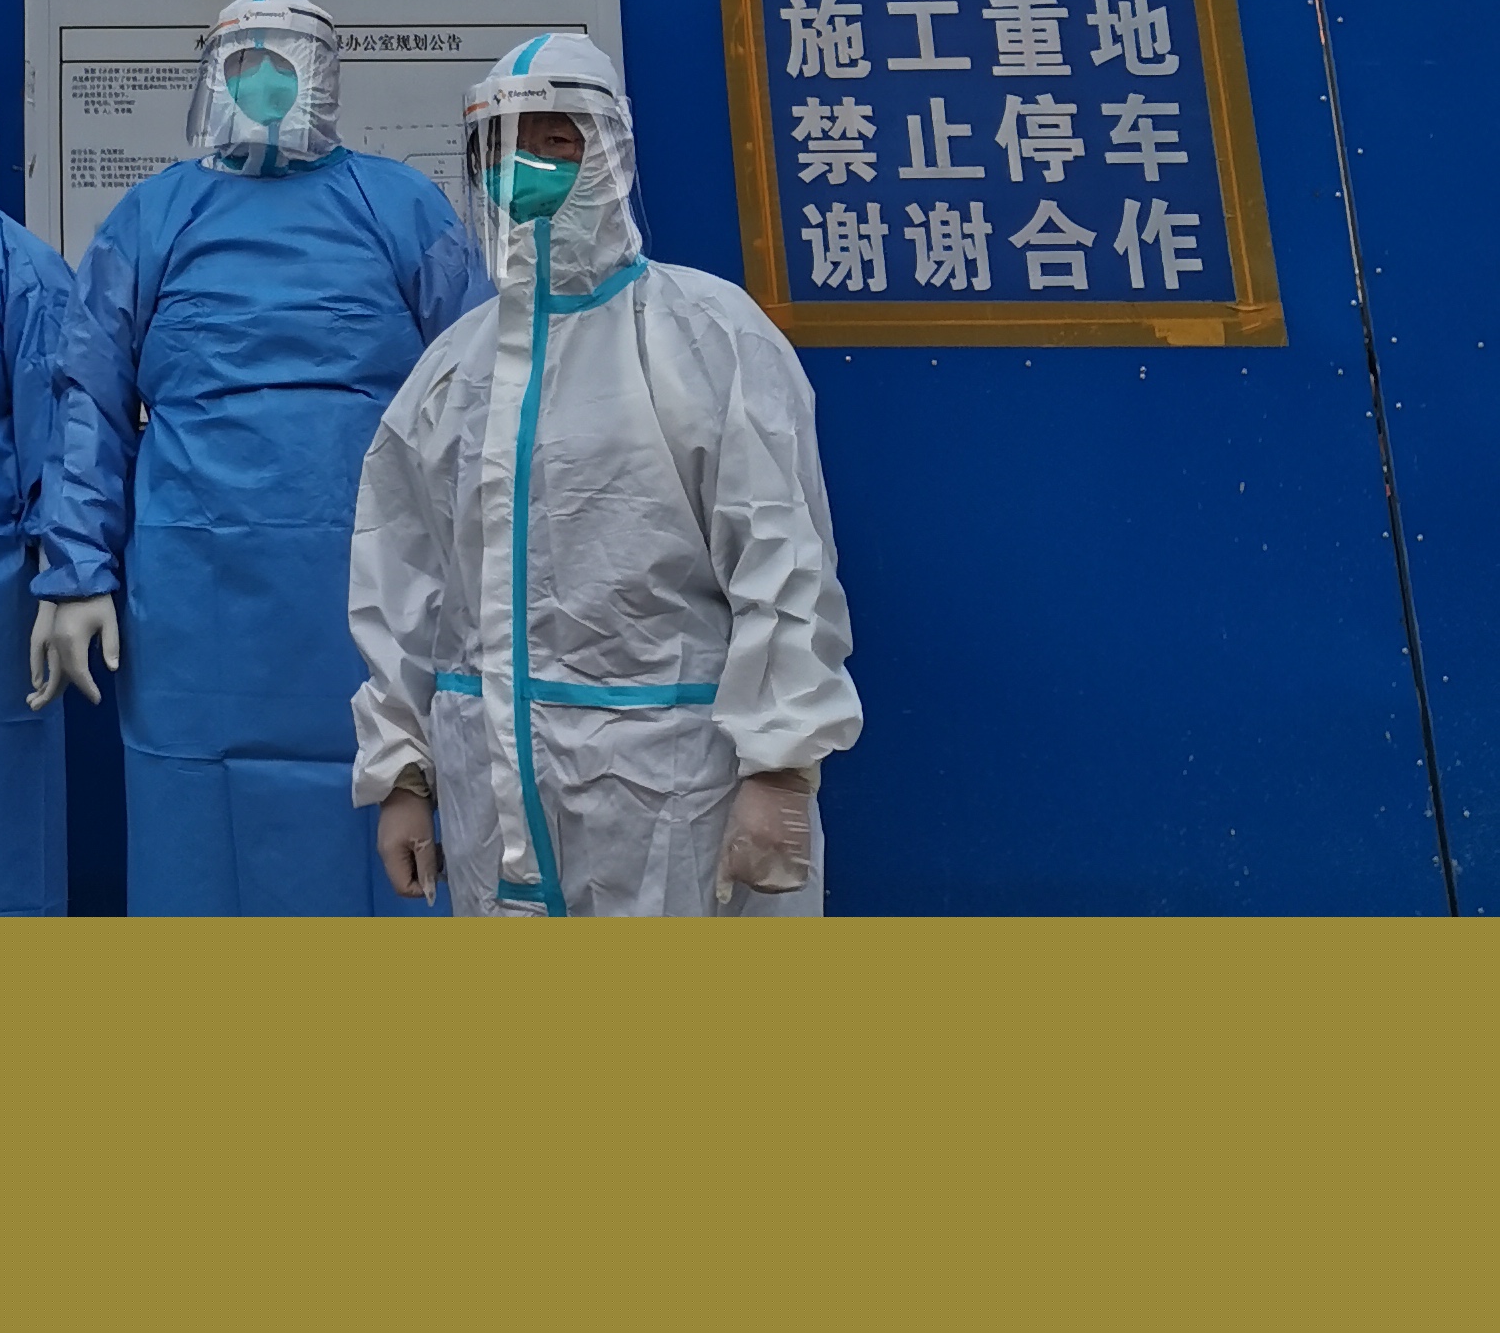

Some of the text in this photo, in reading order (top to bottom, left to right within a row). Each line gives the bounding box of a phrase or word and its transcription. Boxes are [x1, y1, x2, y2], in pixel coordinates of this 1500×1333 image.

[791, 93, 1189, 184] 禁止停车
[801, 198, 1204, 292] 谢谢合作
